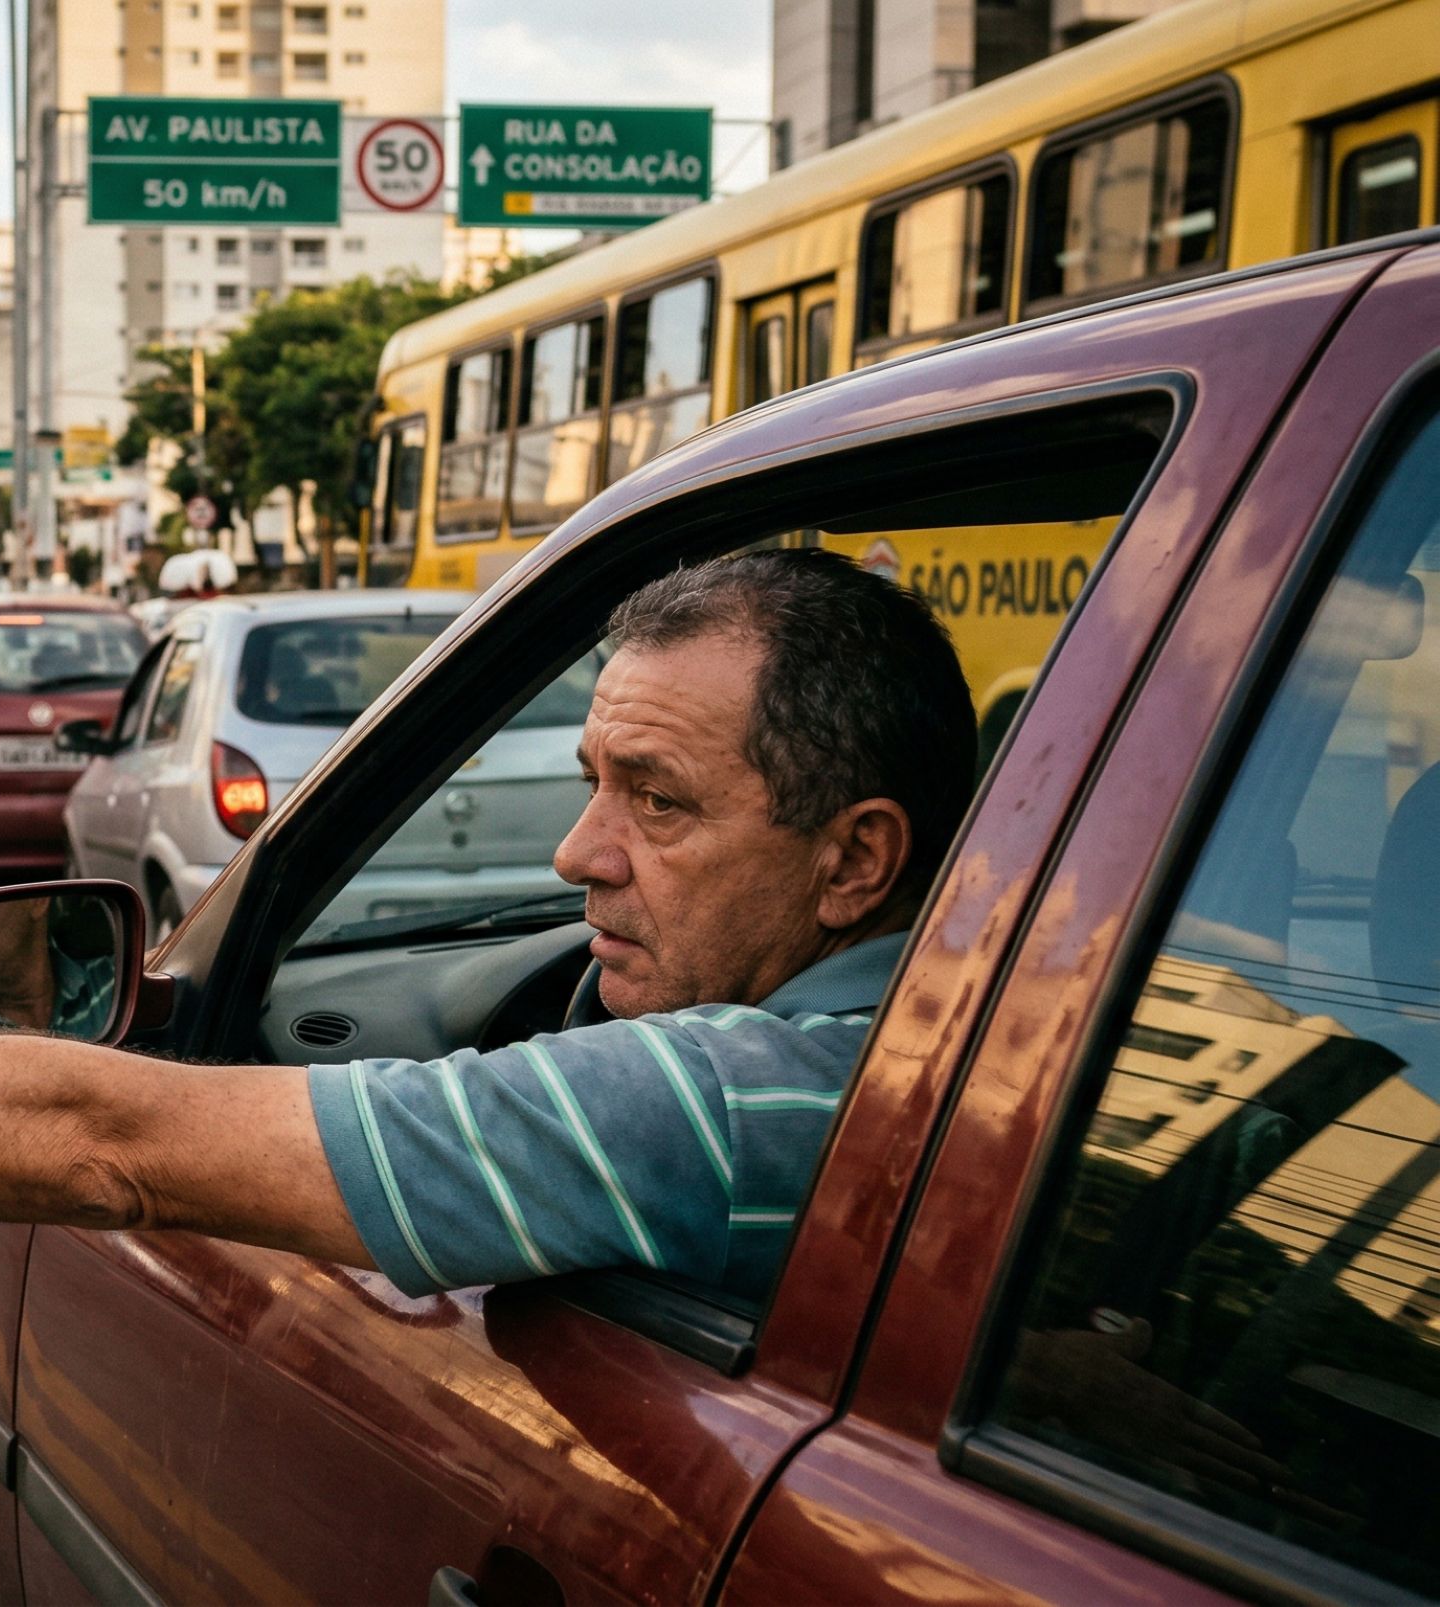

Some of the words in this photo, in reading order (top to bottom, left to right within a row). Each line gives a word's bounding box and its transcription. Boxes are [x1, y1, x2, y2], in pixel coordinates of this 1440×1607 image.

[105, 114, 158, 143] AV.
[168, 115, 325, 145] PAULISTA
[504, 118, 567, 145] RUA
[575, 119, 618, 146] DA
[375, 140, 430, 173] 50
[504, 149, 702, 187] CONSOLAÇÃO
[143, 178, 189, 208] 50
[201, 177, 288, 211] km/h
[977, 555, 1090, 617] PAULO
